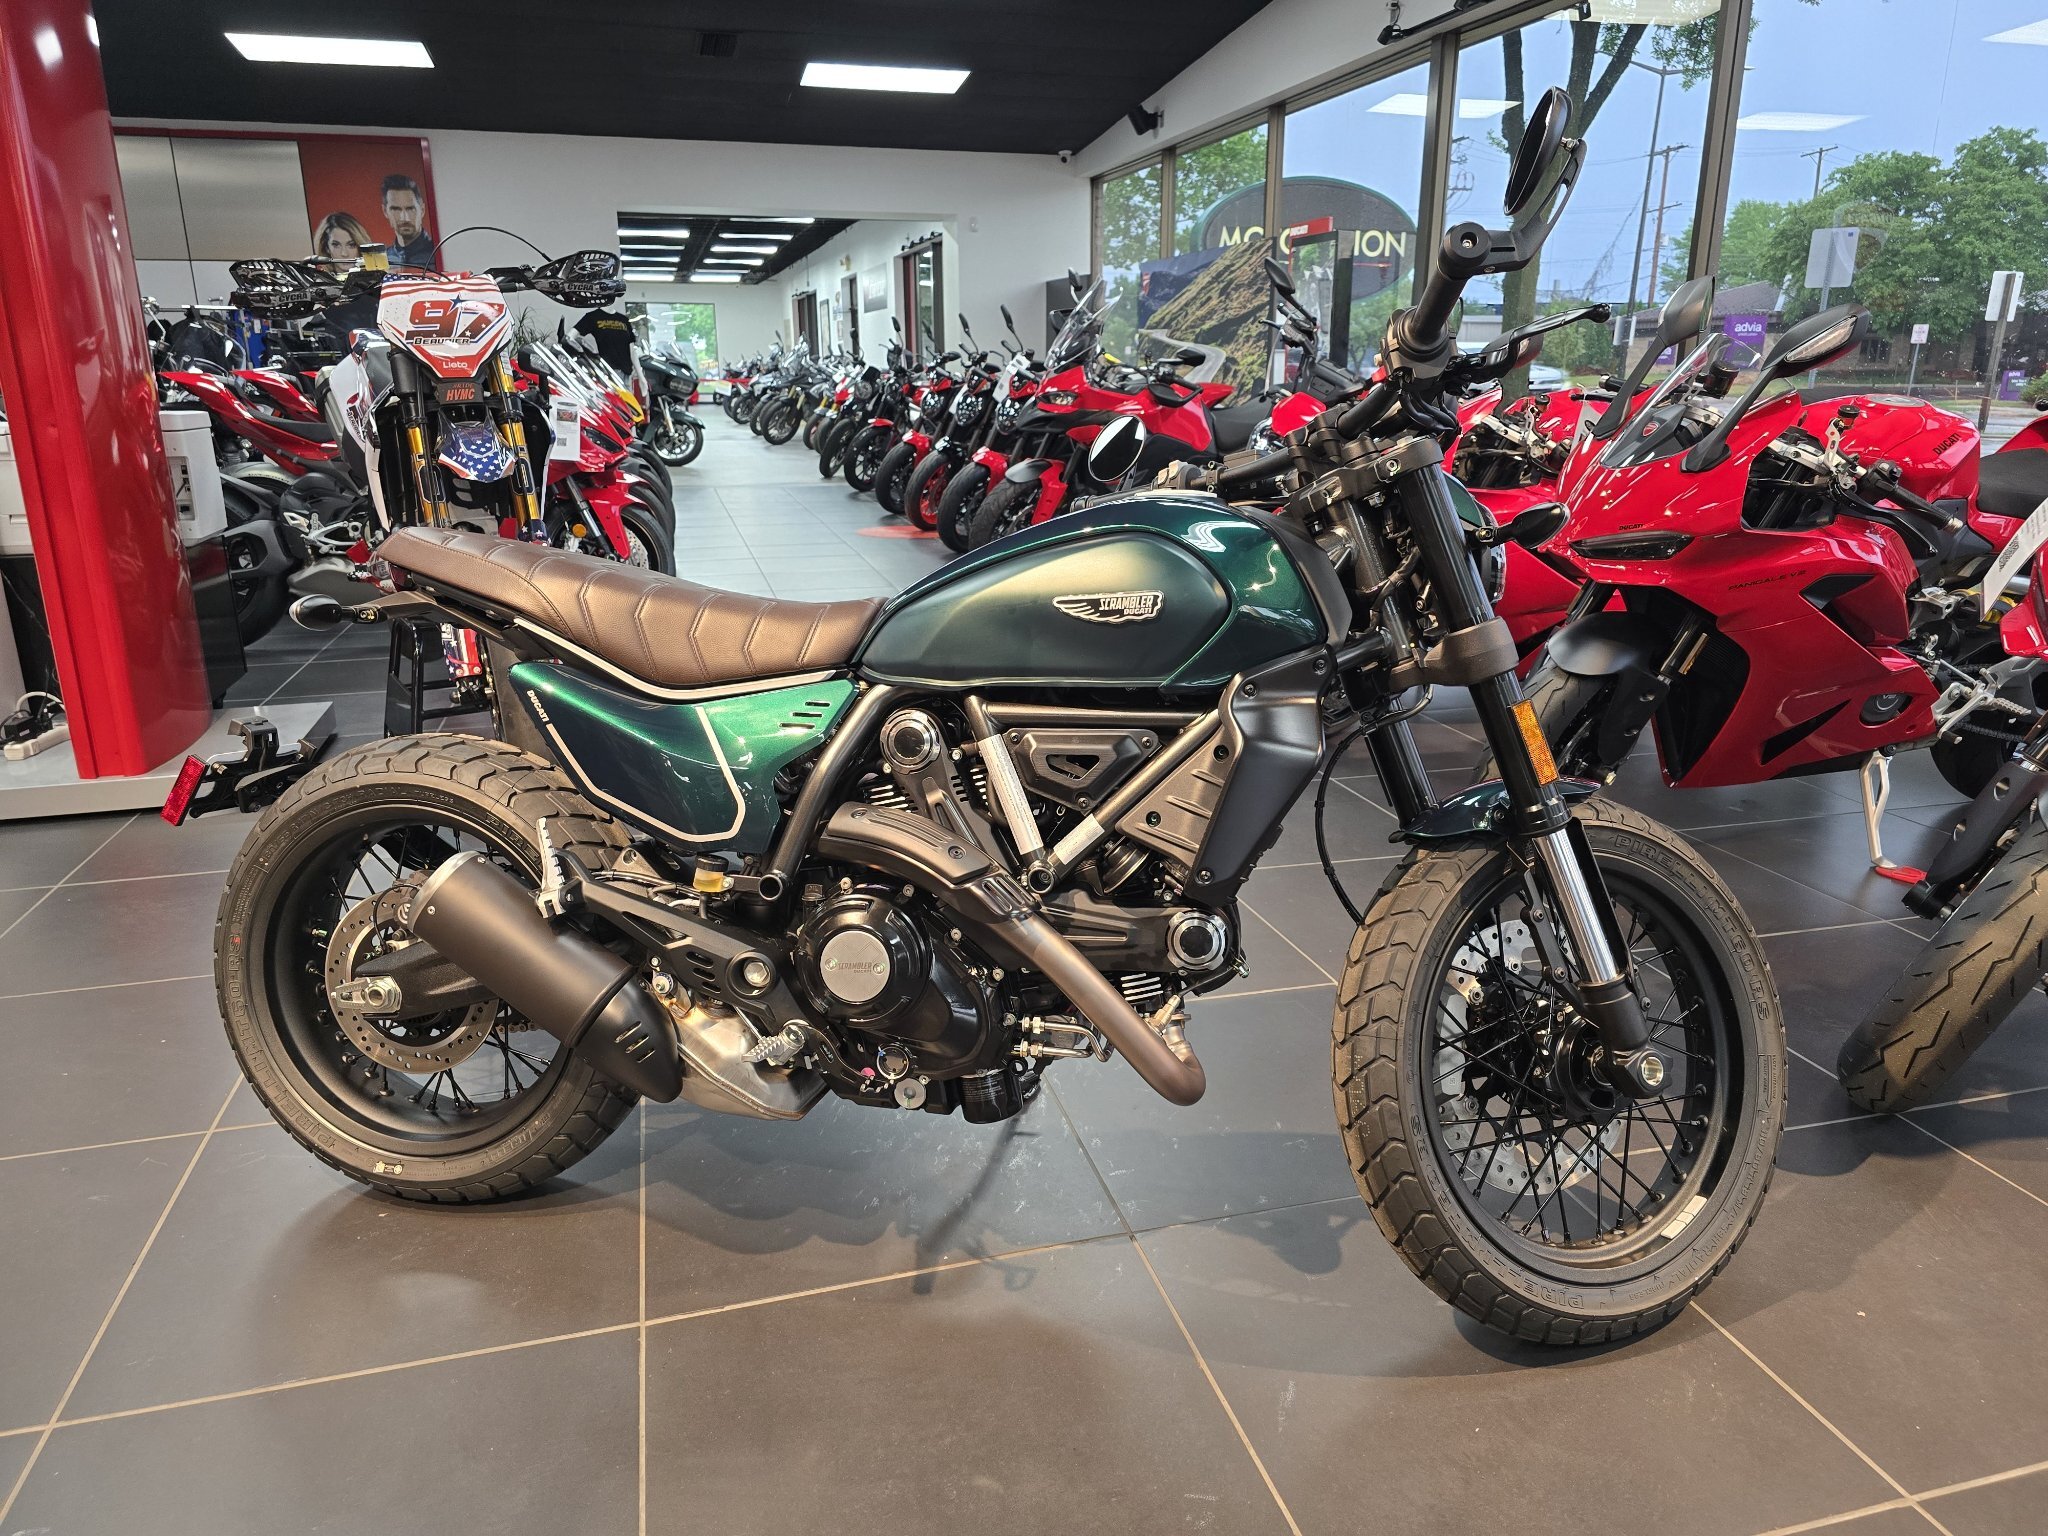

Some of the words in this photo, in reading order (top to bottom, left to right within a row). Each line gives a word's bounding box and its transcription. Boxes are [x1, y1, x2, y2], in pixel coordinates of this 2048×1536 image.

[404, 299, 507, 342] 97
[1734, 321, 1762, 332] advia
[446, 388, 475, 401] HVMC
[1932, 433, 1961, 455] DUCATI
[1619, 523, 1644, 531] DUCATI
[1728, 574, 1786, 591] PANIGALE
[1790, 569, 1807, 577] V2
[1099, 595, 1154, 610] SCRAMBLER
[1123, 607, 1152, 615] DUCATI
[526, 690, 550, 722] DUCATI
[485, 812, 542, 866] PIRE
[1615, 834, 1708, 898] PIRELLI
[838, 962, 872, 970] SCRAMBLER
